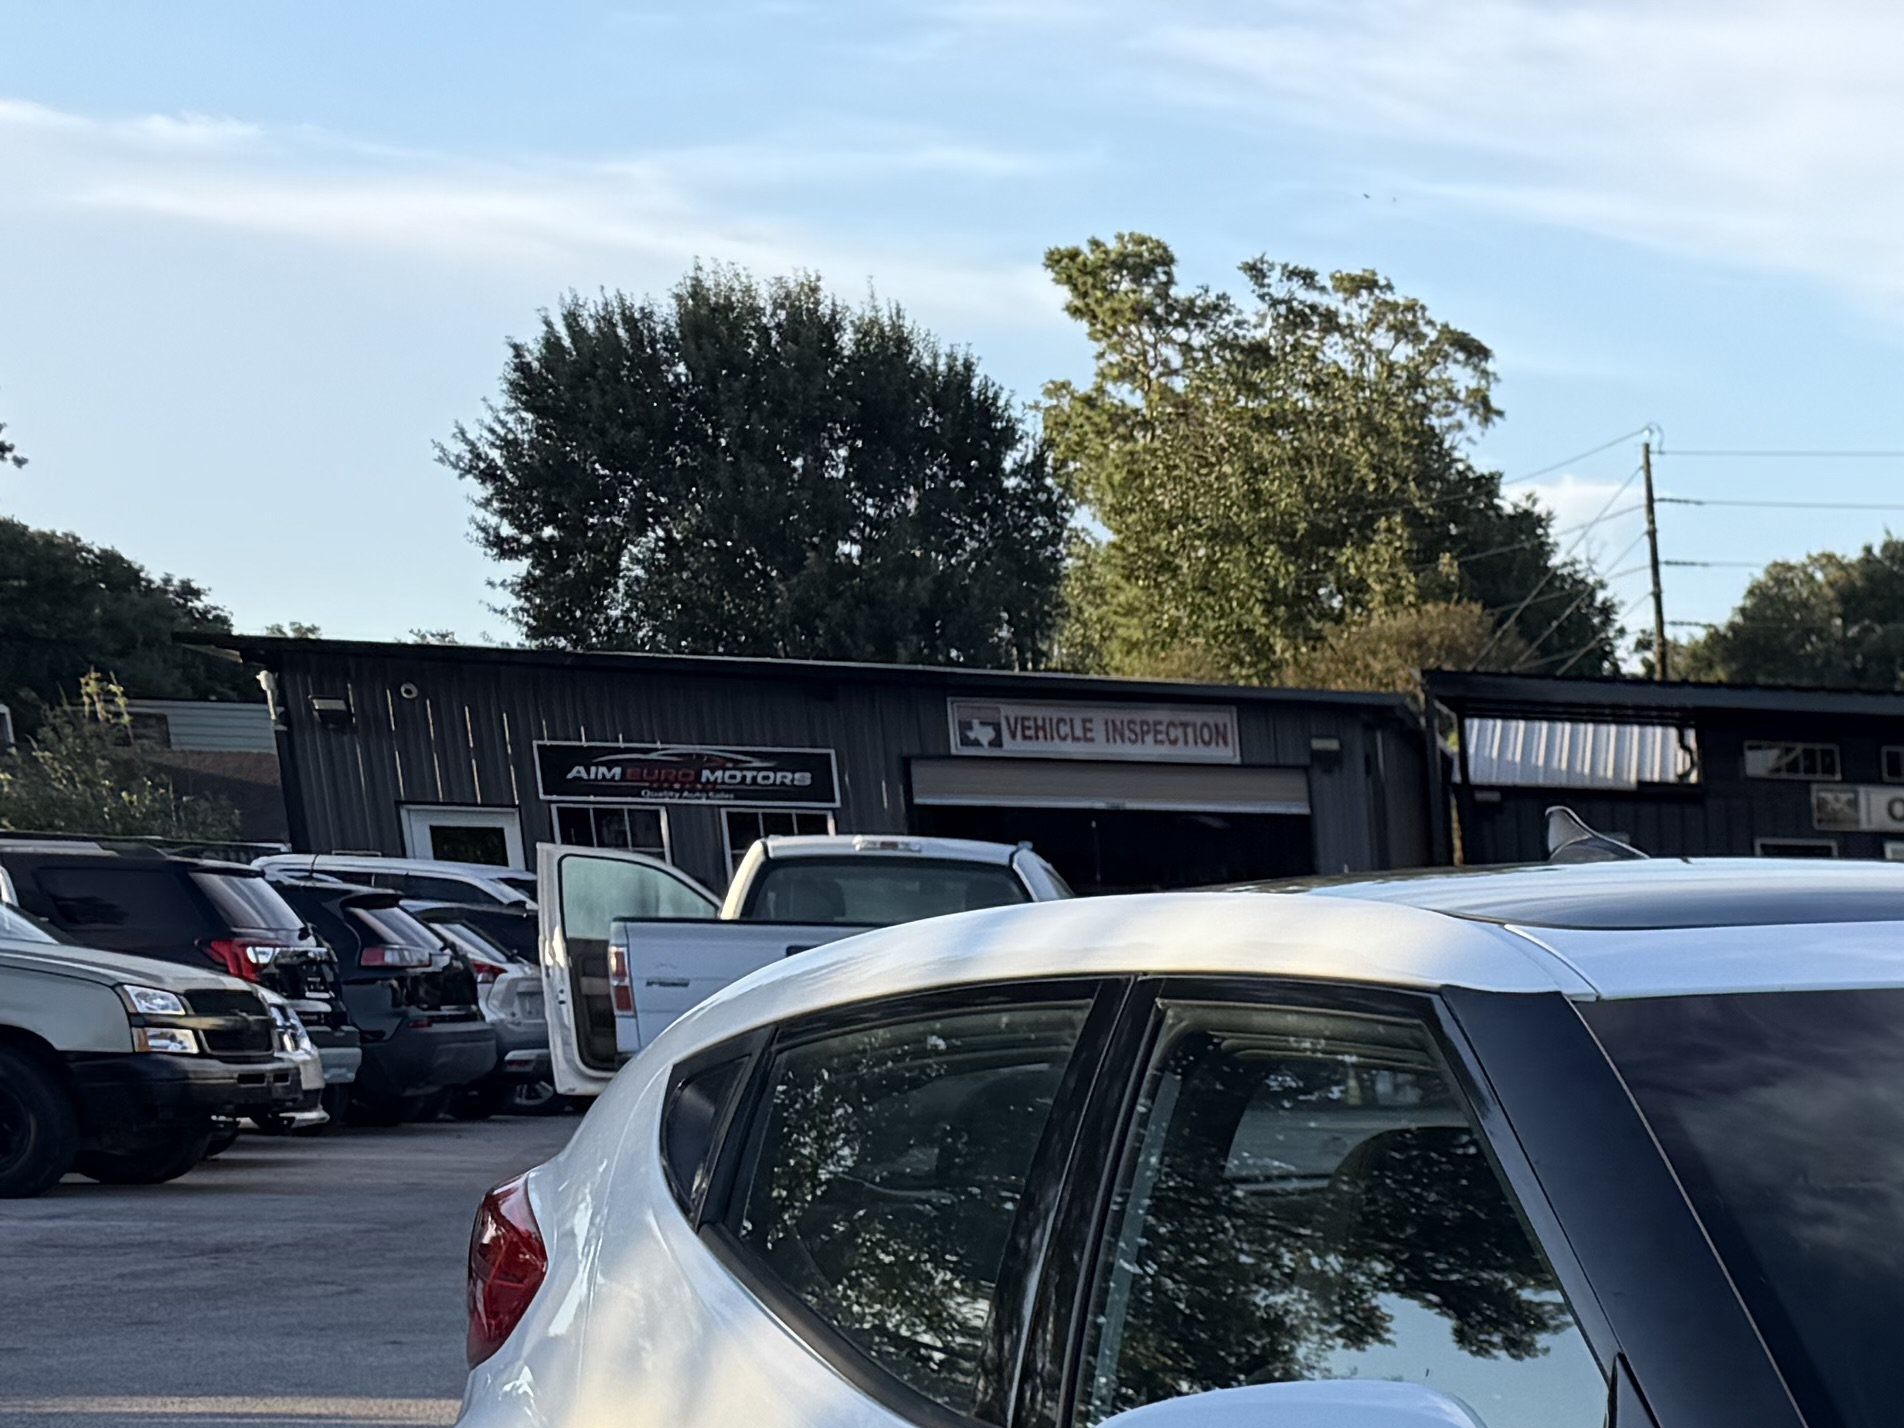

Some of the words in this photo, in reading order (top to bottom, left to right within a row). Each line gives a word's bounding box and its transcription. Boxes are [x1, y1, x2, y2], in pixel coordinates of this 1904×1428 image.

[1004, 715, 1096, 743] VEHICLE
[1104, 717, 1230, 748] INSPECTION
[566, 765, 622, 780] AIM
[626, 767, 696, 782] EURO
[701, 769, 812, 786] MOTORS
